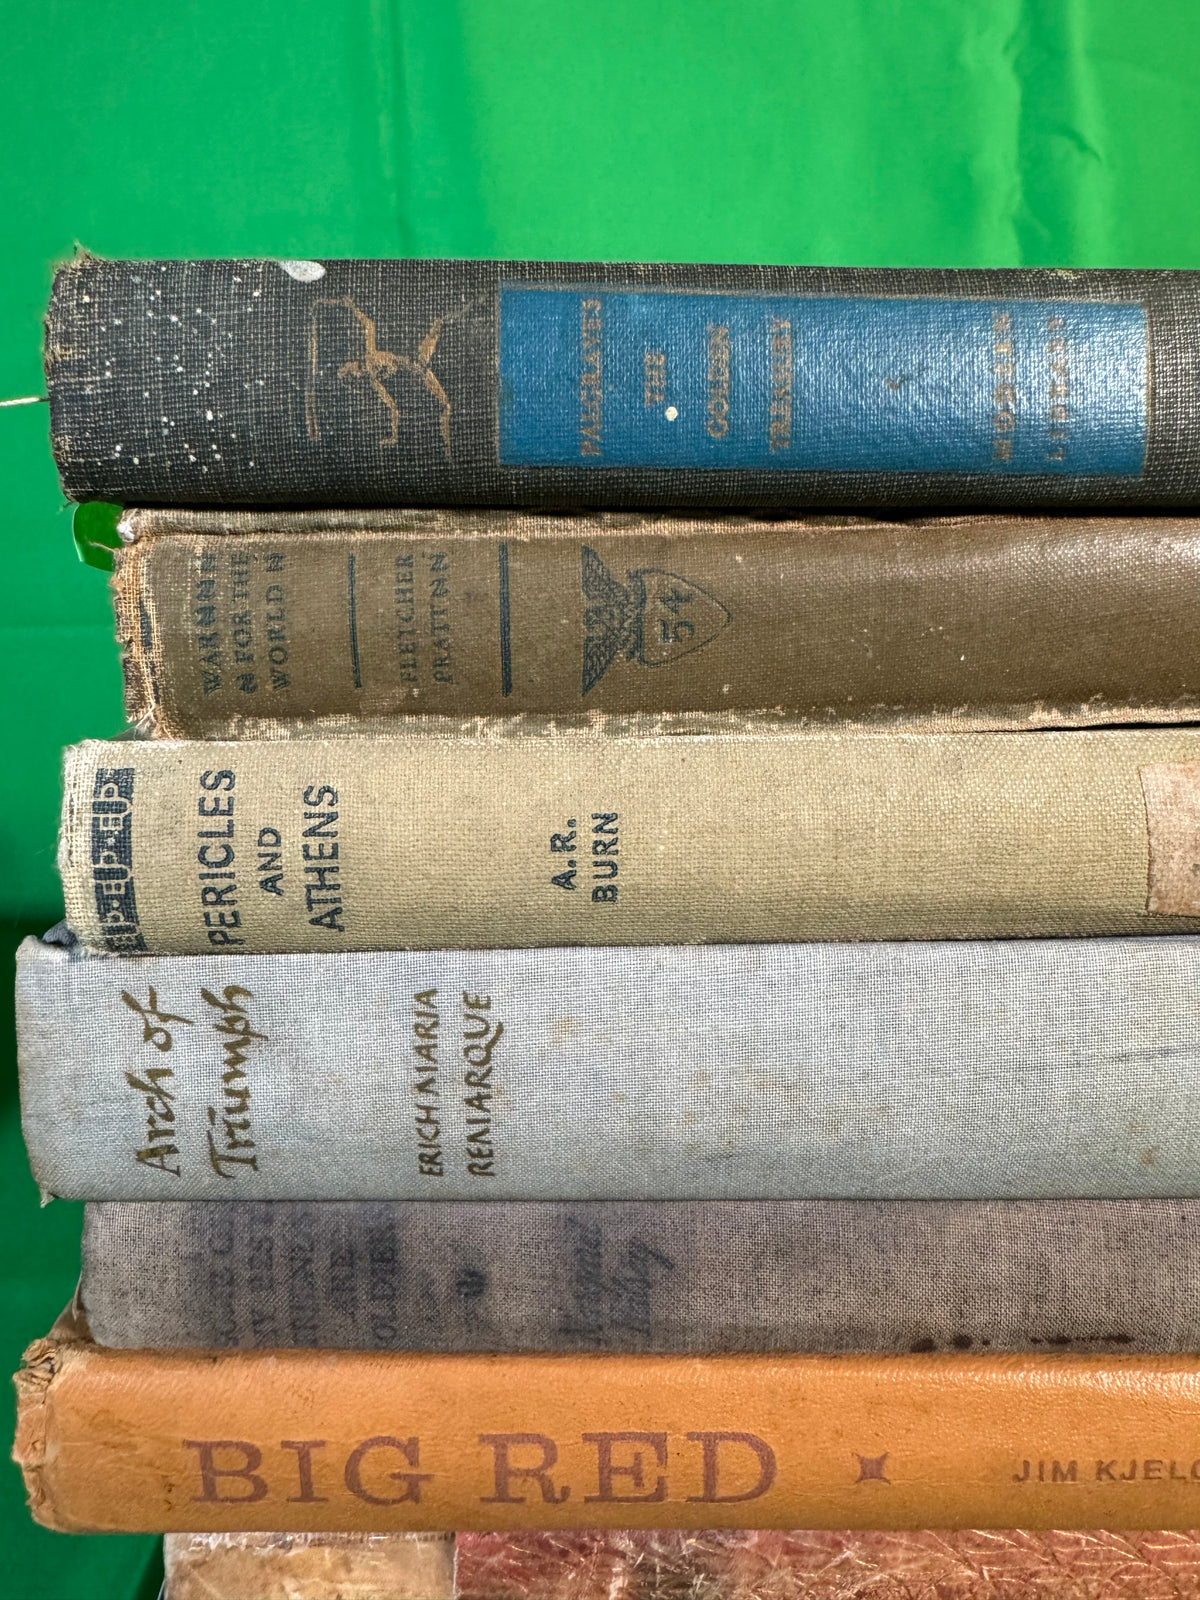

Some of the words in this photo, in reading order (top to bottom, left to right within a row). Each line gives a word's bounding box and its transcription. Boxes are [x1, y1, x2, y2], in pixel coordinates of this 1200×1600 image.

[645, 351, 667, 406] THE
[708, 321, 731, 439] GOLDEN
[769, 315, 793, 453] TREASURY
[992, 310, 1016, 462] MODERN
[1047, 316, 1069, 461] LIBRARY
[230, 551, 250, 602] THE
[395, 553, 419, 684] FLETCHER
[658, 588, 695, 643] 54
[198, 631, 222, 694] WAR
[233, 609, 255, 664] FOR
[266, 584, 292, 692] WORLD
[430, 603, 454, 686] PRATT
[198, 769, 246, 946] PERICLES
[257, 827, 284, 897] AND
[302, 785, 345, 932] ATHENS
[591, 812, 619, 903] BURN
[121, 985, 194, 1052] of
[413, 988, 440, 1097] MARIA
[125, 1067, 182, 1178] Arch
[201, 985, 269, 1179] Triumph
[463, 990, 504, 1178] REMARQUE
[414, 1103, 443, 1177] ERICH
[182, 1435, 435, 1507] BIG
[478, 1432, 778, 1503] RED
[1012, 1459, 1079, 1483] JIM
